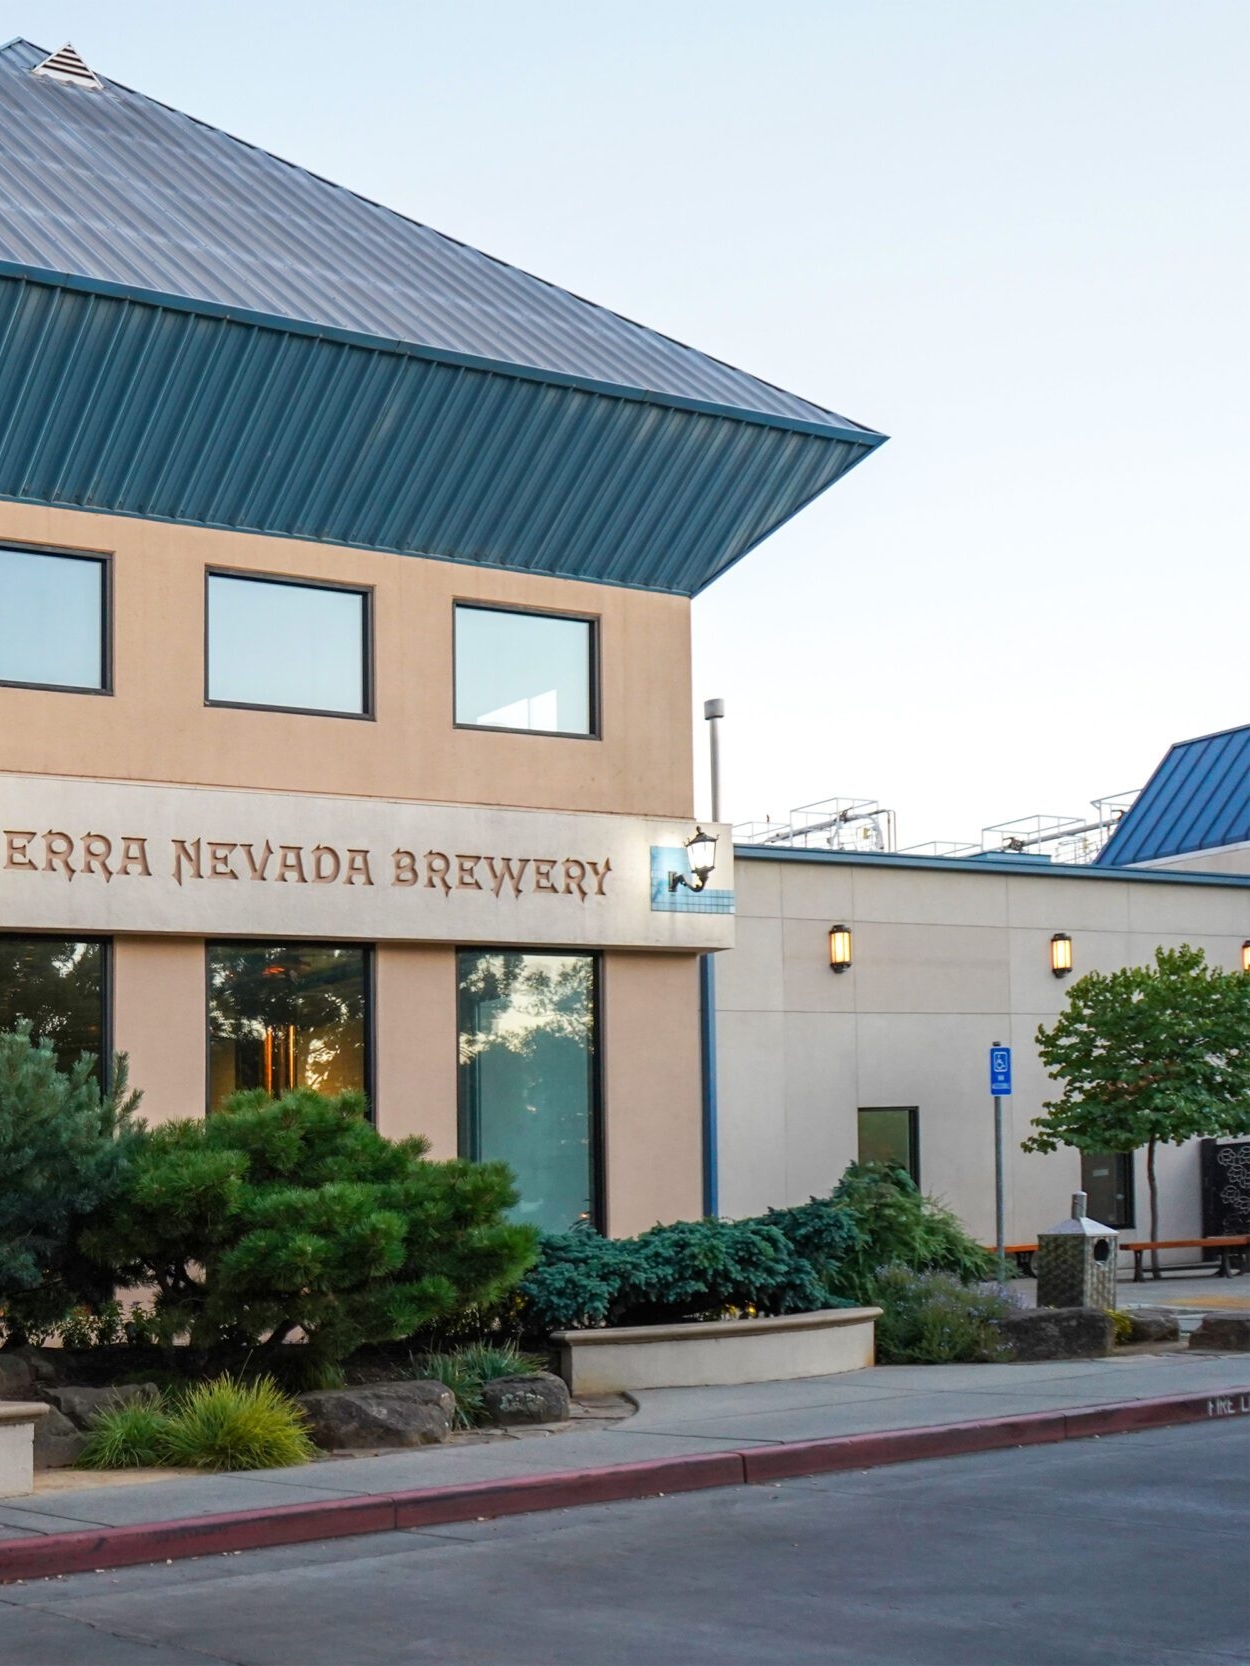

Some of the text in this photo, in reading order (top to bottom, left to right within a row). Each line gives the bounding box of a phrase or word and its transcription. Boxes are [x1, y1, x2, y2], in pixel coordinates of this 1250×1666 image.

[171, 837, 375, 887] NEVADA
[391, 848, 612, 903] BREWERY
[1208, 1399, 1236, 1416] FIRE
